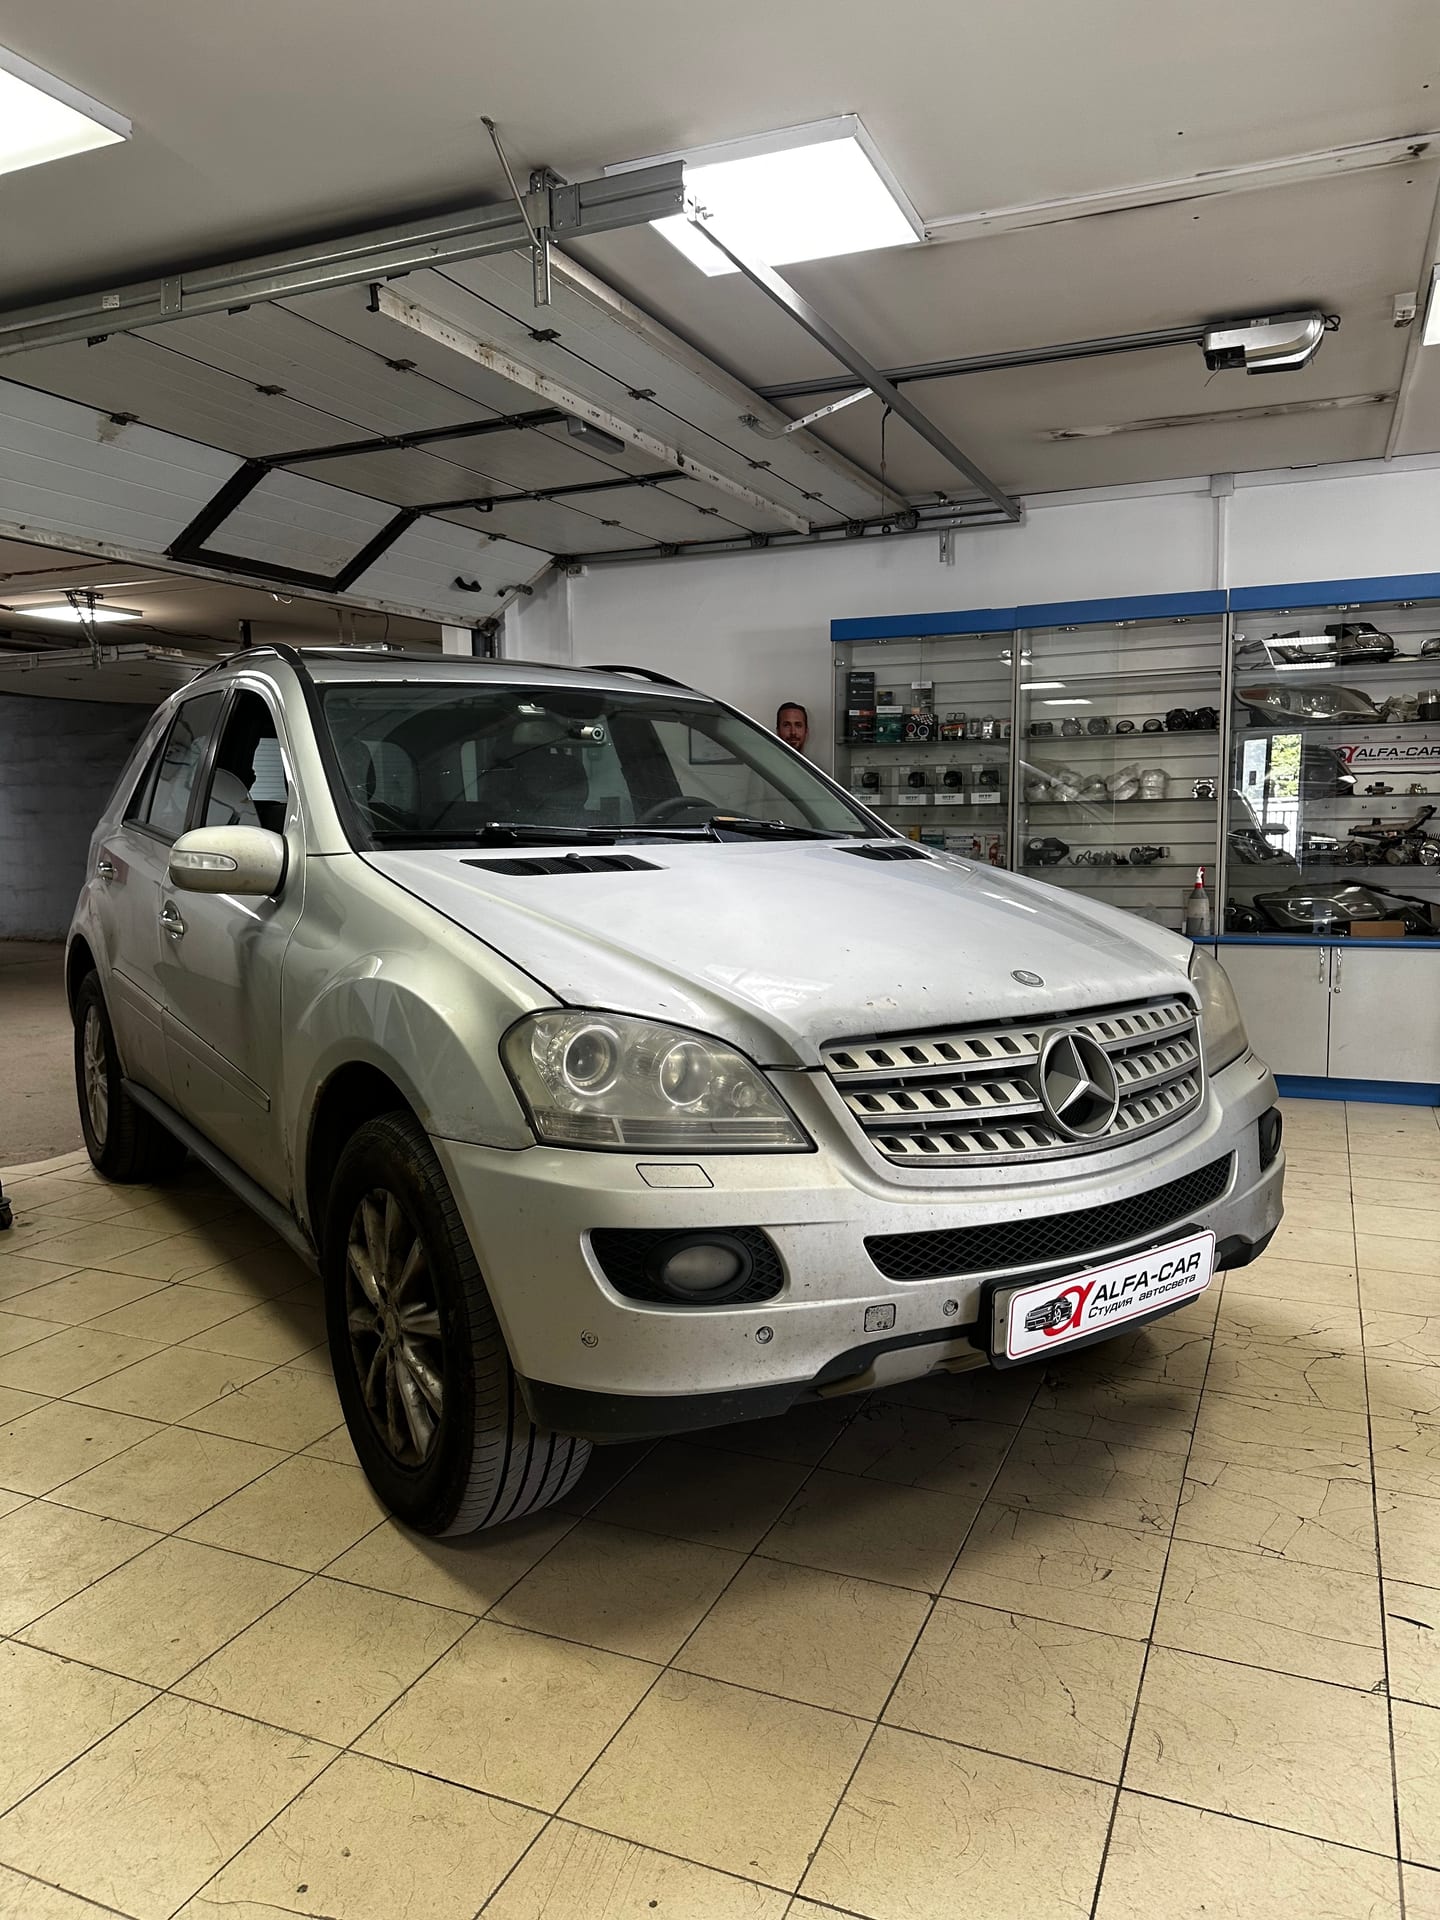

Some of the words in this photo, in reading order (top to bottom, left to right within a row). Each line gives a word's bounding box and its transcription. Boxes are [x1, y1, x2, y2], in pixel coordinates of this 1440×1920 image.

[1355, 746, 1440, 758] ALFA-CAR
[1088, 1297, 1133, 1319] Студия
[1138, 1274, 1197, 1301] автосвета
[1091, 1252, 1201, 1306] ALFA-CAR
